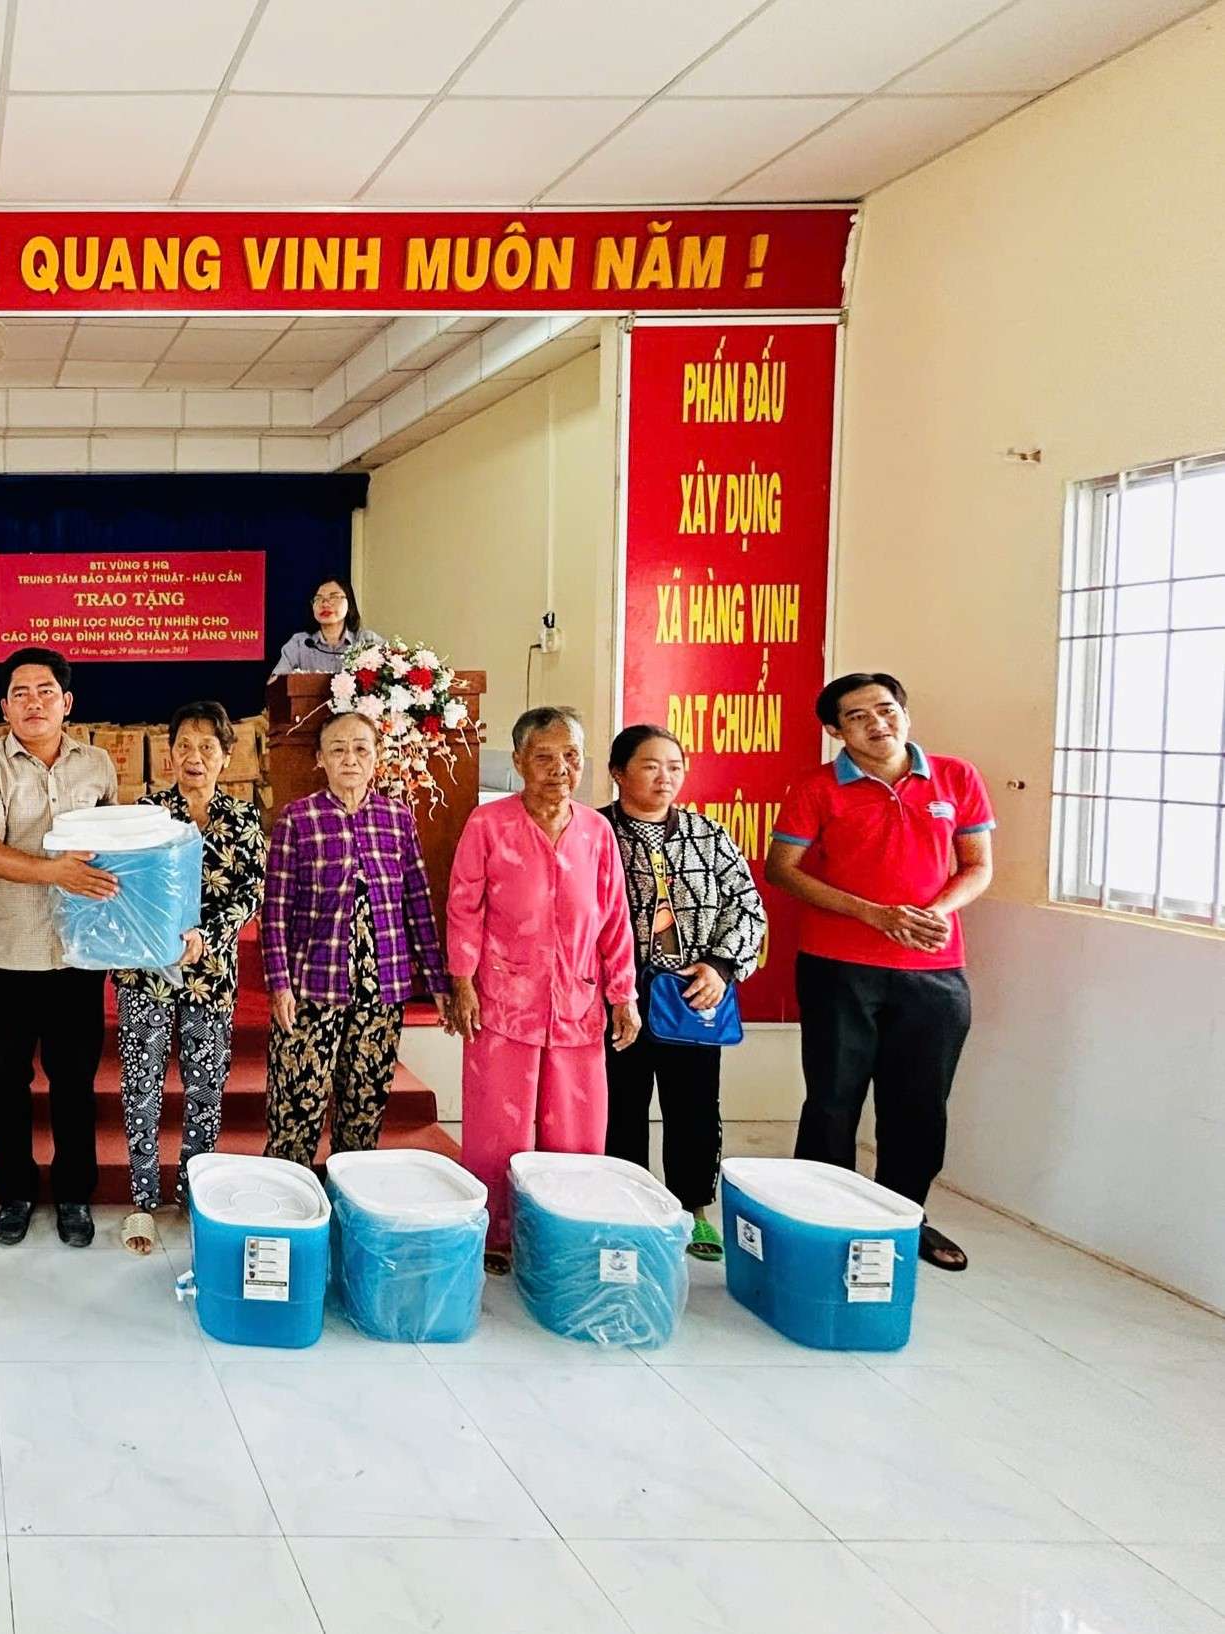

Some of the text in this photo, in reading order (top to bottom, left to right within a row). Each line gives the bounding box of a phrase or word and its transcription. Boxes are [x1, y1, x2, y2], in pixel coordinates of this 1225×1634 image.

[21, 236, 221, 293] QUANG
[245, 236, 380, 292] VINH
[405, 222, 574, 292] MUÔN
[594, 220, 726, 290] NĂM
[745, 234, 769, 288] !
[682, 335, 786, 423] PHẤN ĐẤU
[678, 459, 781, 552] XÂY DỰNG
[17, 575, 53, 584] TRUNG
[56, 573, 78, 584] TÂM
[81, 572, 104, 584] BẢO
[106, 572, 131, 584] ĐẢM
[134, 571, 148, 583] KỸ
[150, 572, 184, 585] THUẬT
[192, 572, 215, 584] HẬU
[217, 570, 242, 583] CẦN
[89, 559, 170, 571] BTL VÙNG 5 HQ
[30, 615, 230, 630] 100 BÌNH LỌC NƯỚC TỰ NHIÊN CHO
[73, 590, 185, 610] TRAO TẶNG
[655, 567, 800, 661] XÃ HÀNG VỊNH
[1, 631, 28, 643] CÁC
[30, 631, 49, 644] HỘ
[52, 633, 74, 642] GIA
[76, 631, 105, 642] ĐÌNH
[108, 630, 134, 641] KHÓ
[172, 629, 190, 641] XÃ
[192, 628, 227, 640] HÀNG
[230, 630, 259, 643] VỊNH
[712, 664, 781, 753] CHUẨN
